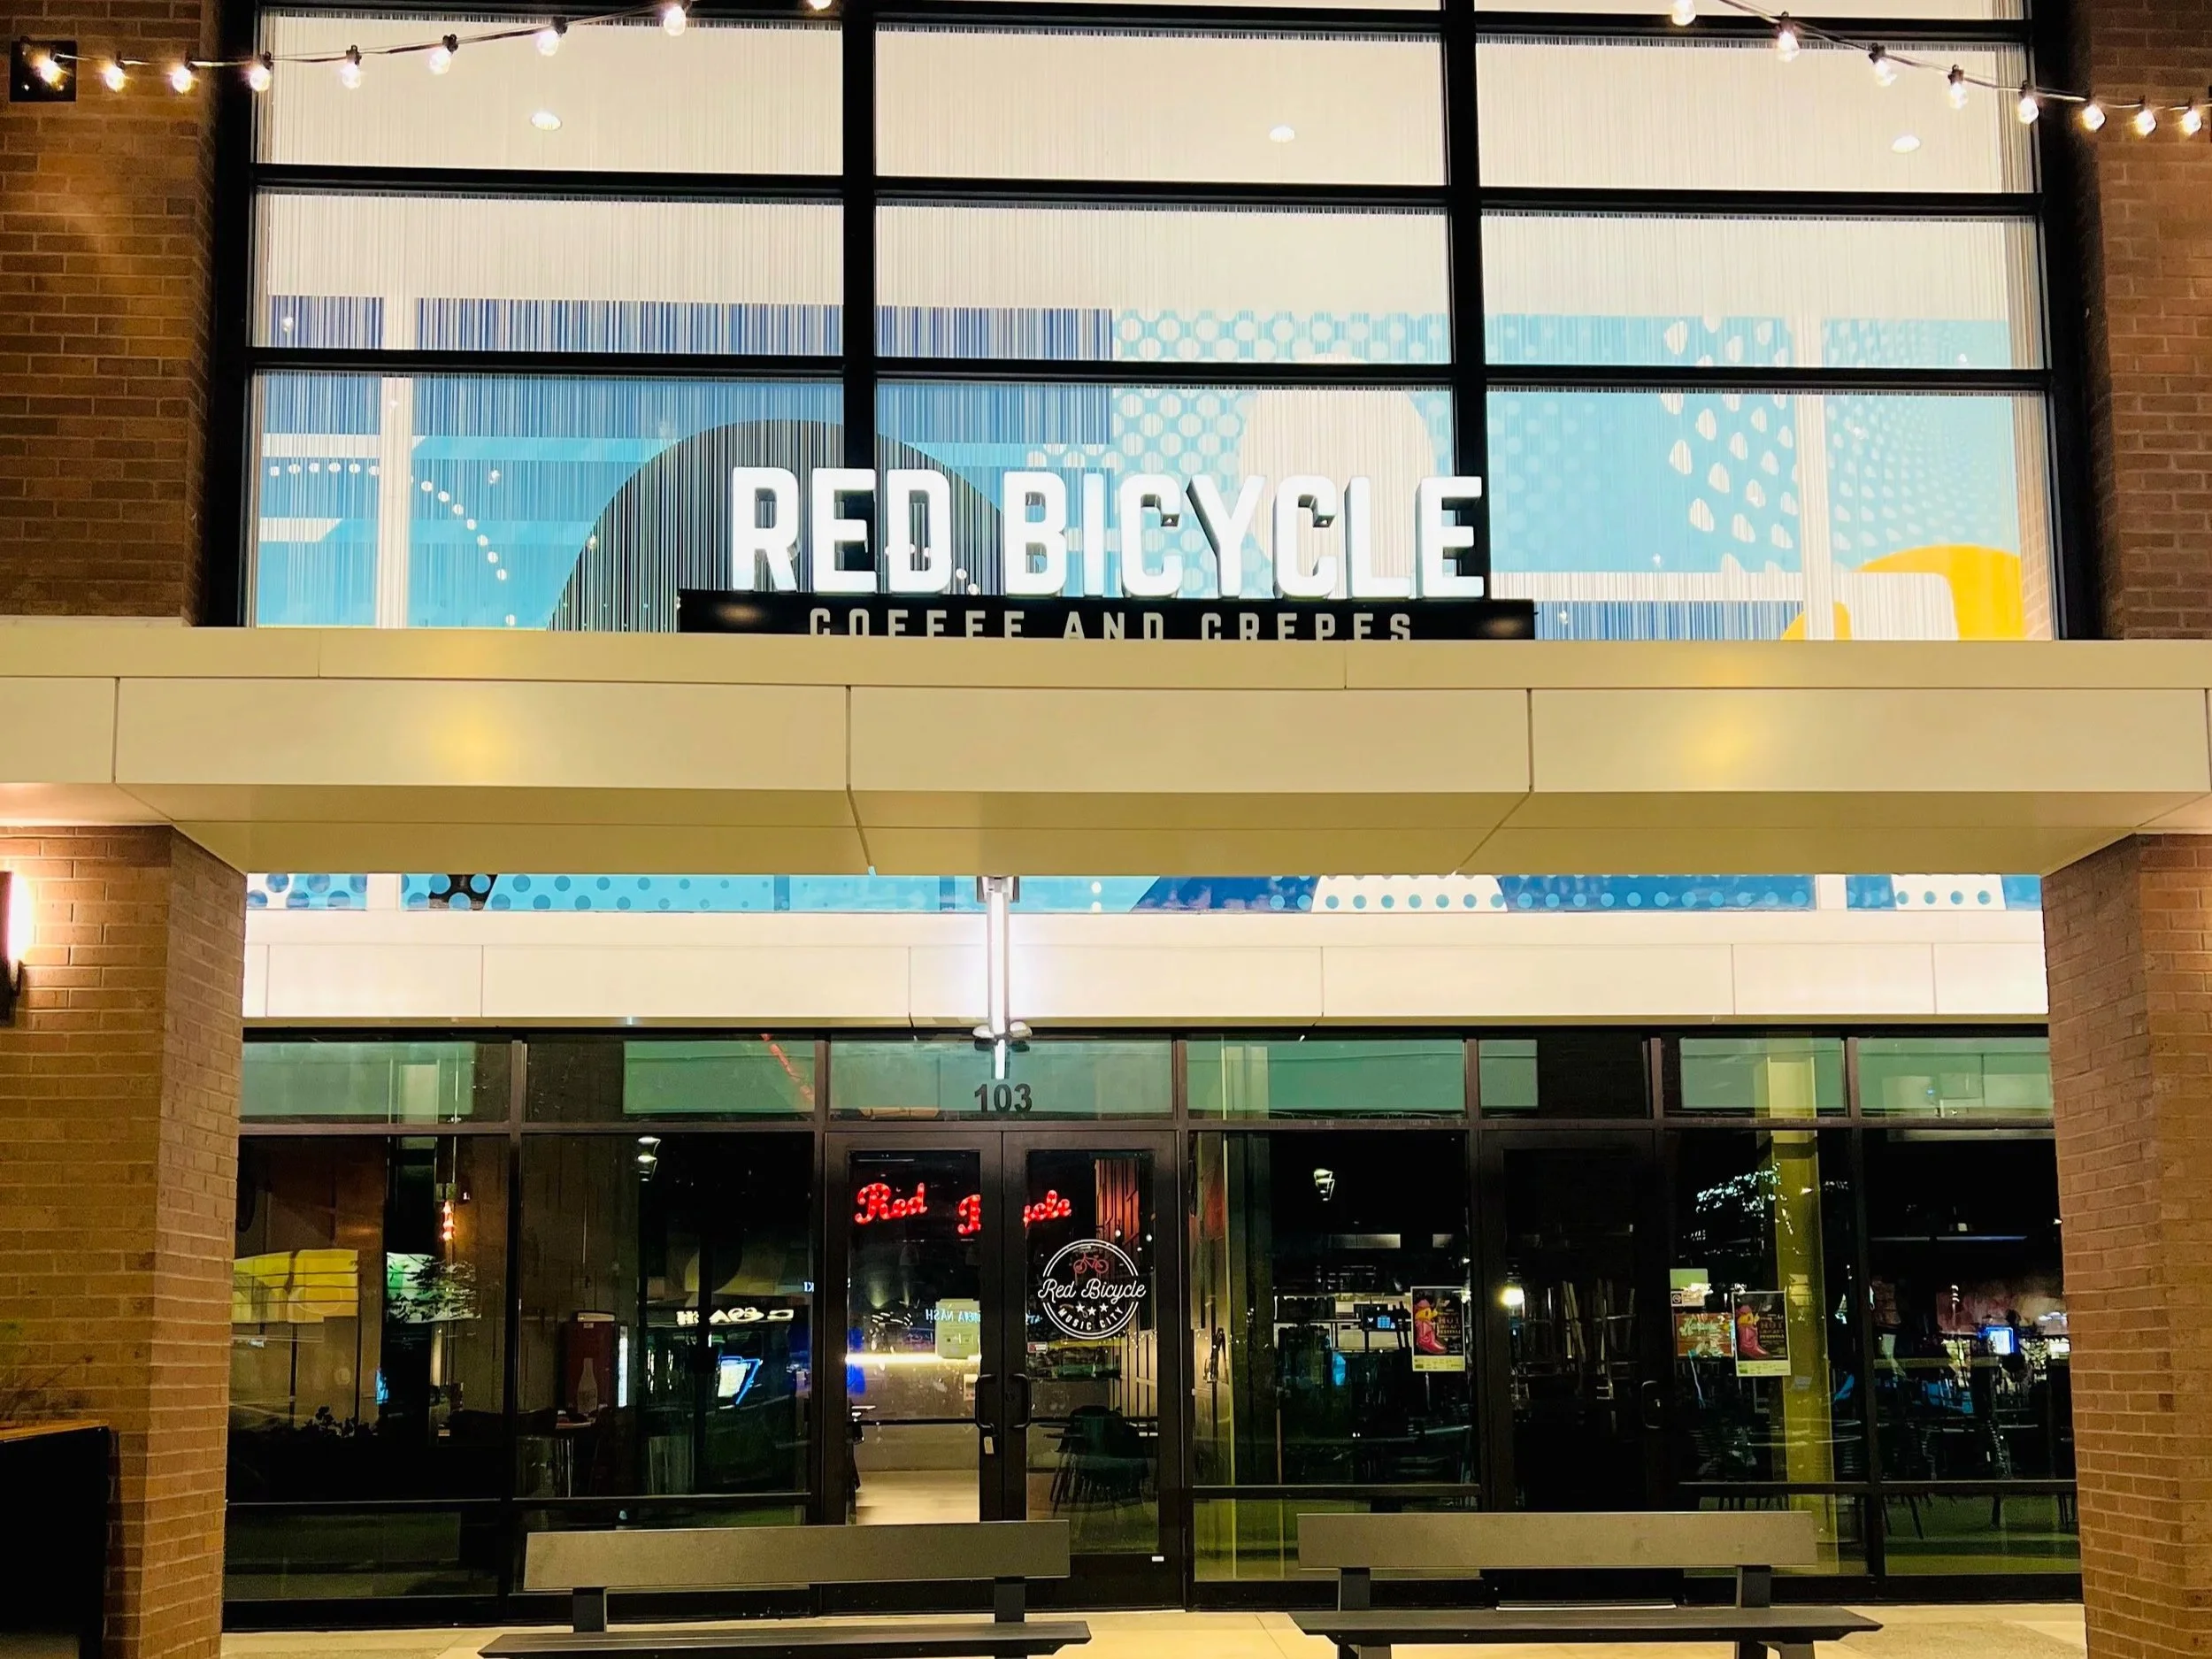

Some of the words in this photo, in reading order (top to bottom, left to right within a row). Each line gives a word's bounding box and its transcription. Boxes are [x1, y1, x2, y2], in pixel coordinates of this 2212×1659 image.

[733, 466, 951, 594] RED
[1003, 471, 1484, 597] BICYCLE
[810, 608, 1025, 638] COFFEE
[1063, 611, 1164, 640] AND
[1201, 612, 1411, 641] CREPES
[974, 1083, 1033, 1112] 103
[855, 1182, 928, 1225] Red
[1038, 1278, 1077, 1303] Red
[1081, 1278, 1147, 1305] Bicycle
[1058, 1308, 1092, 1331] MUSIC
[1099, 1306, 1124, 1328] CITY
